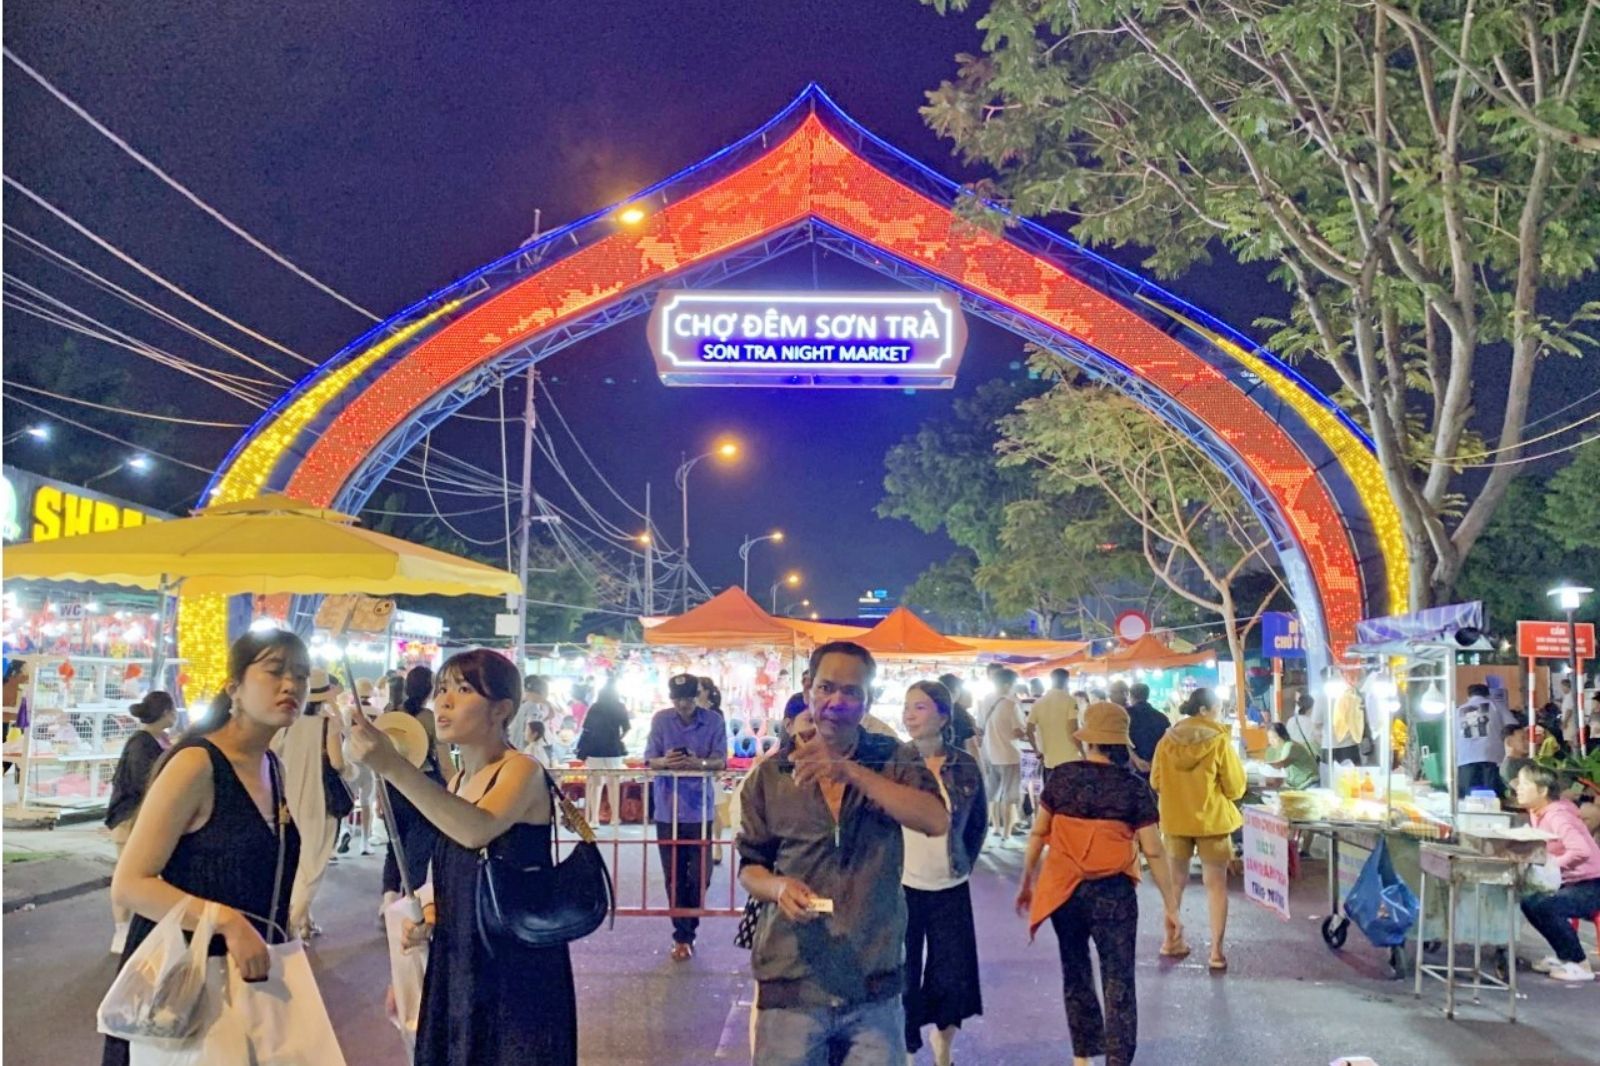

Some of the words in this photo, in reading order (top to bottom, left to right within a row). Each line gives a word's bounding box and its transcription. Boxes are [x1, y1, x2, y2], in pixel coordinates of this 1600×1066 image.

[674, 313, 738, 342] CHỢ
[741, 308, 807, 338] ĐÊM
[815, 313, 876, 338] SƠN
[884, 309, 940, 339] TRÀ
[744, 345, 777, 360] TRA
[781, 345, 835, 361] NIGHT
[839, 346, 910, 362] MARKET
[61, 601, 81, 616] WC
